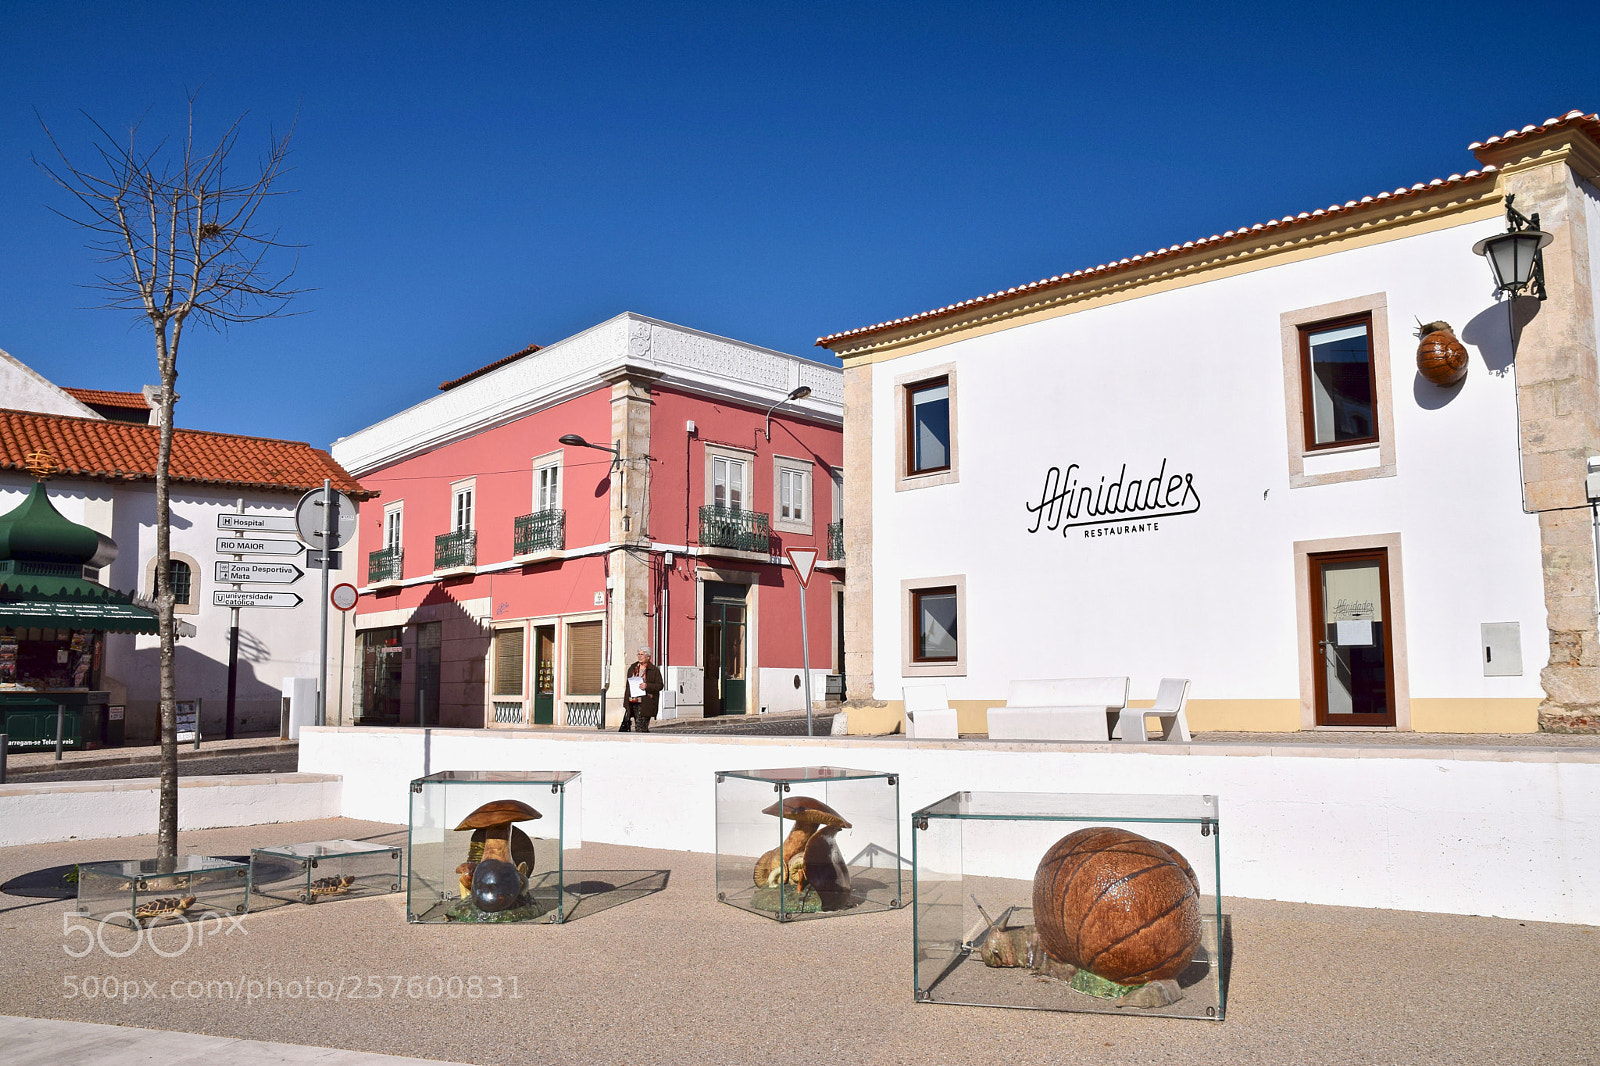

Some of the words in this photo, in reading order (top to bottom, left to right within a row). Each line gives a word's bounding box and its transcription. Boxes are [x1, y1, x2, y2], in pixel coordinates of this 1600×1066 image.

[1026, 458, 1201, 536] Afinidades
[233, 518, 265, 527] Hospital
[1084, 522, 1160, 538] RESTAURANTE
[220, 541, 235, 549] RIO
[236, 541, 265, 550] MAIOR
[230, 564, 250, 572] Zona
[252, 565, 293, 574] Desportiva
[225, 593, 273, 601] universidade
[7, 739, 41, 747] arregam-se
